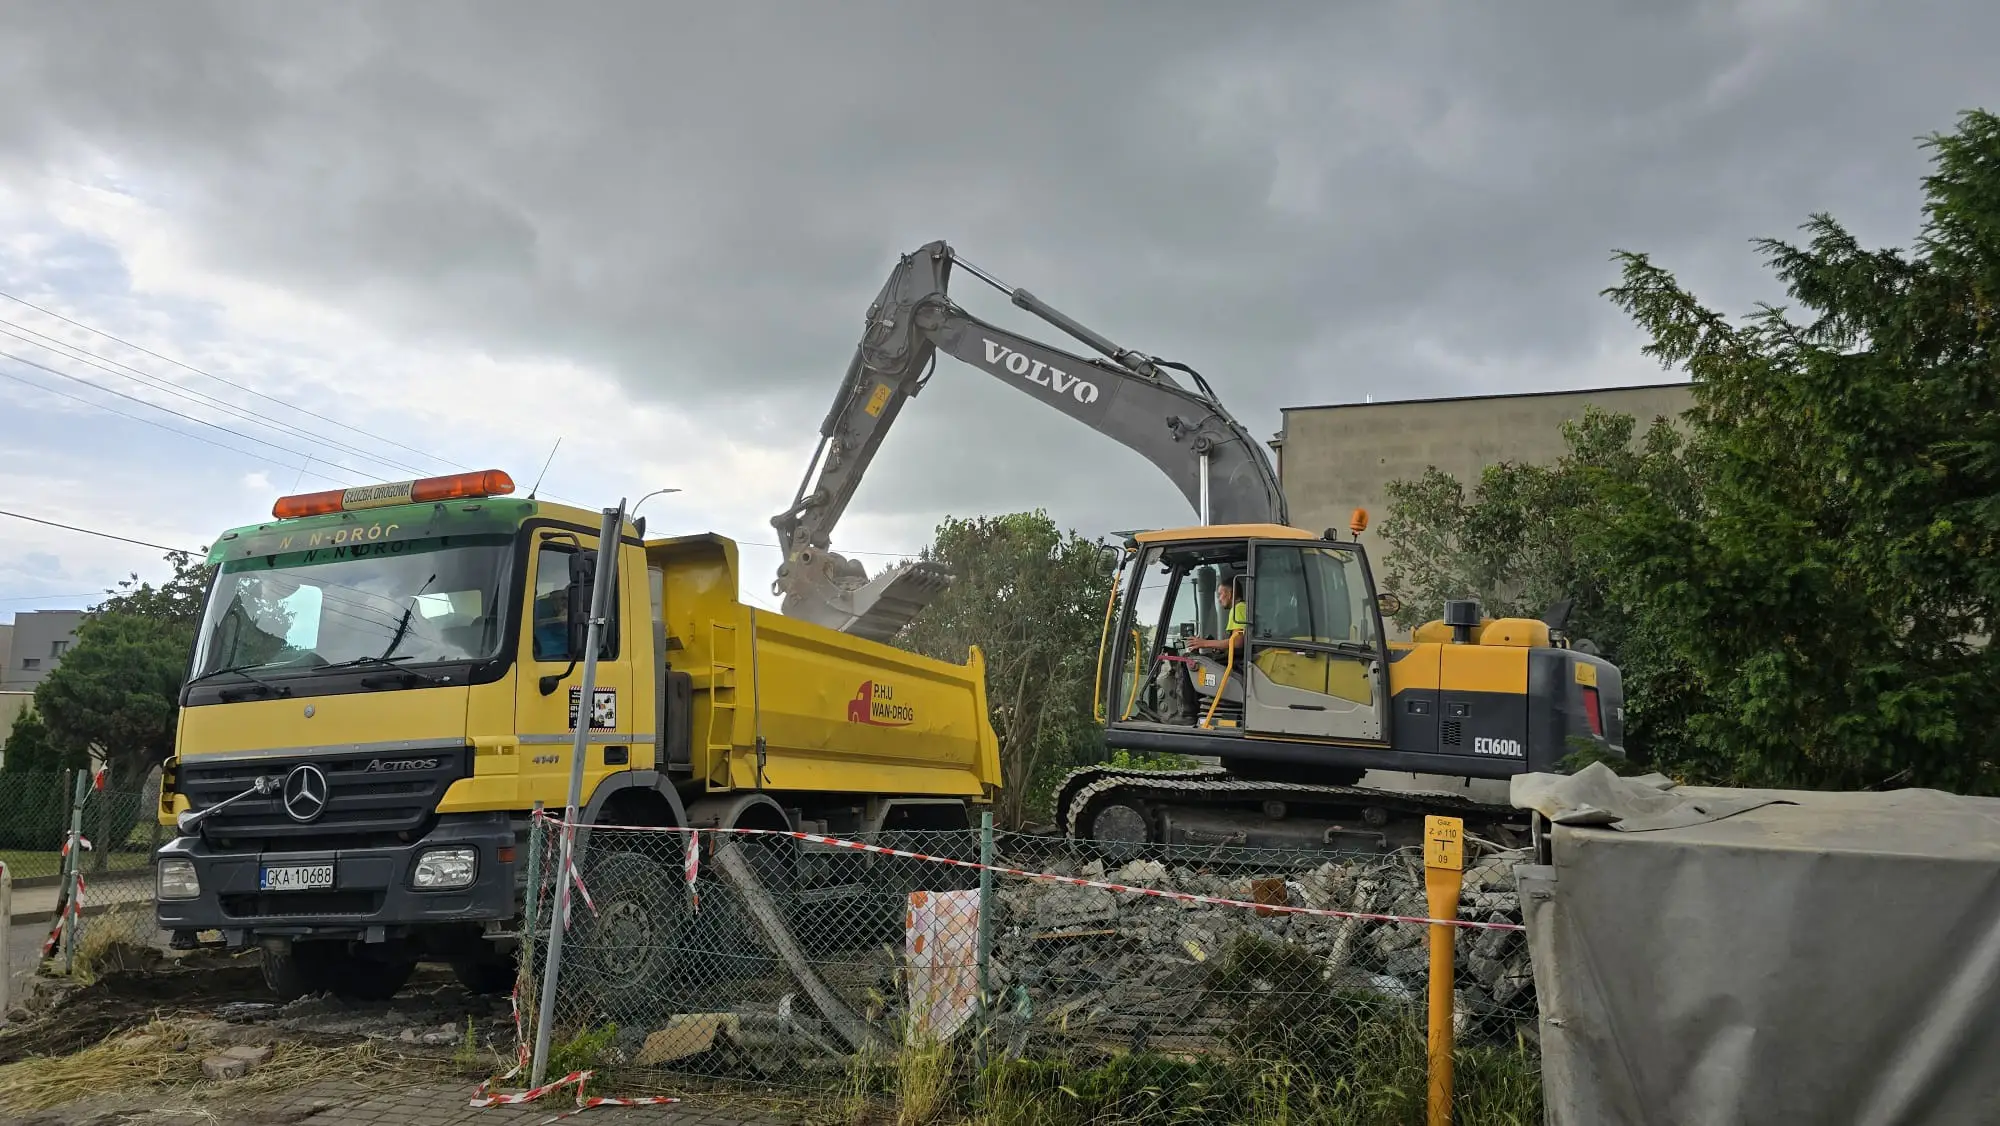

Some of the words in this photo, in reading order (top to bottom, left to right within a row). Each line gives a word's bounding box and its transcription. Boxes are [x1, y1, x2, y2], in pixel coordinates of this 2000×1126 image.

[982, 338, 1099, 404] VOLVO
[871, 701, 914, 721] WAN-DRÓG
[532, 755, 560, 764] 4141
[1445, 829, 1457, 838] 110
[267, 868, 290, 886] GKA
[295, 867, 332, 885] 10688
